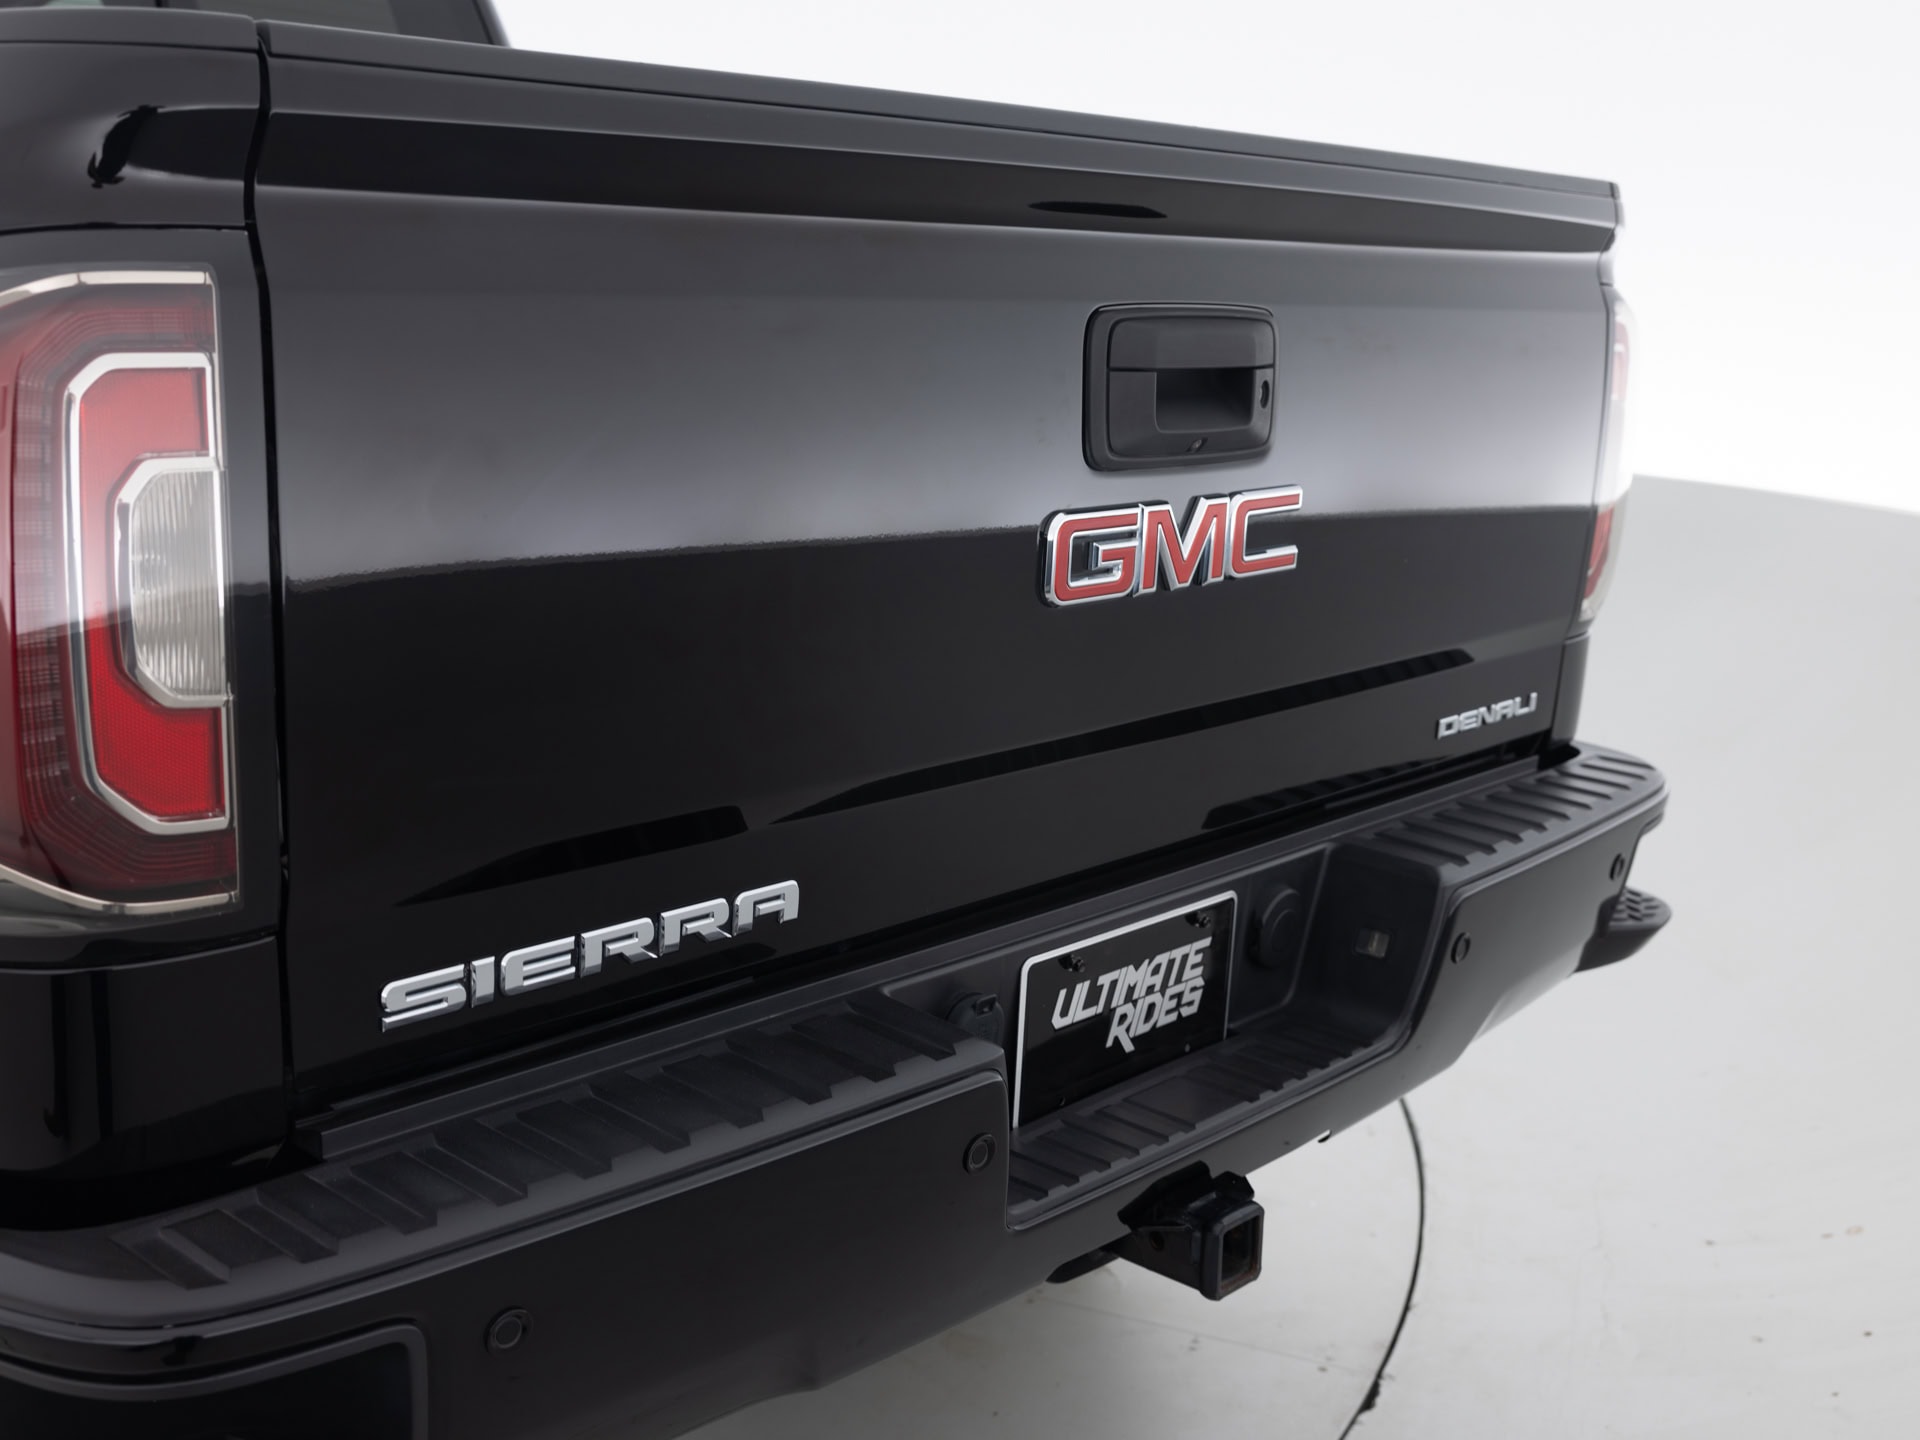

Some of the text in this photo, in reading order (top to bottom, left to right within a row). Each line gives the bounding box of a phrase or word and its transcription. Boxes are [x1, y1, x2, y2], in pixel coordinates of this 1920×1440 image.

[1038, 484, 1303, 607] GMC
[1435, 691, 1538, 741] DENALI
[379, 879, 800, 1033] SIERRA
[1051, 936, 1213, 1031] ULTIMATE
[1105, 975, 1205, 1054] RIDES
